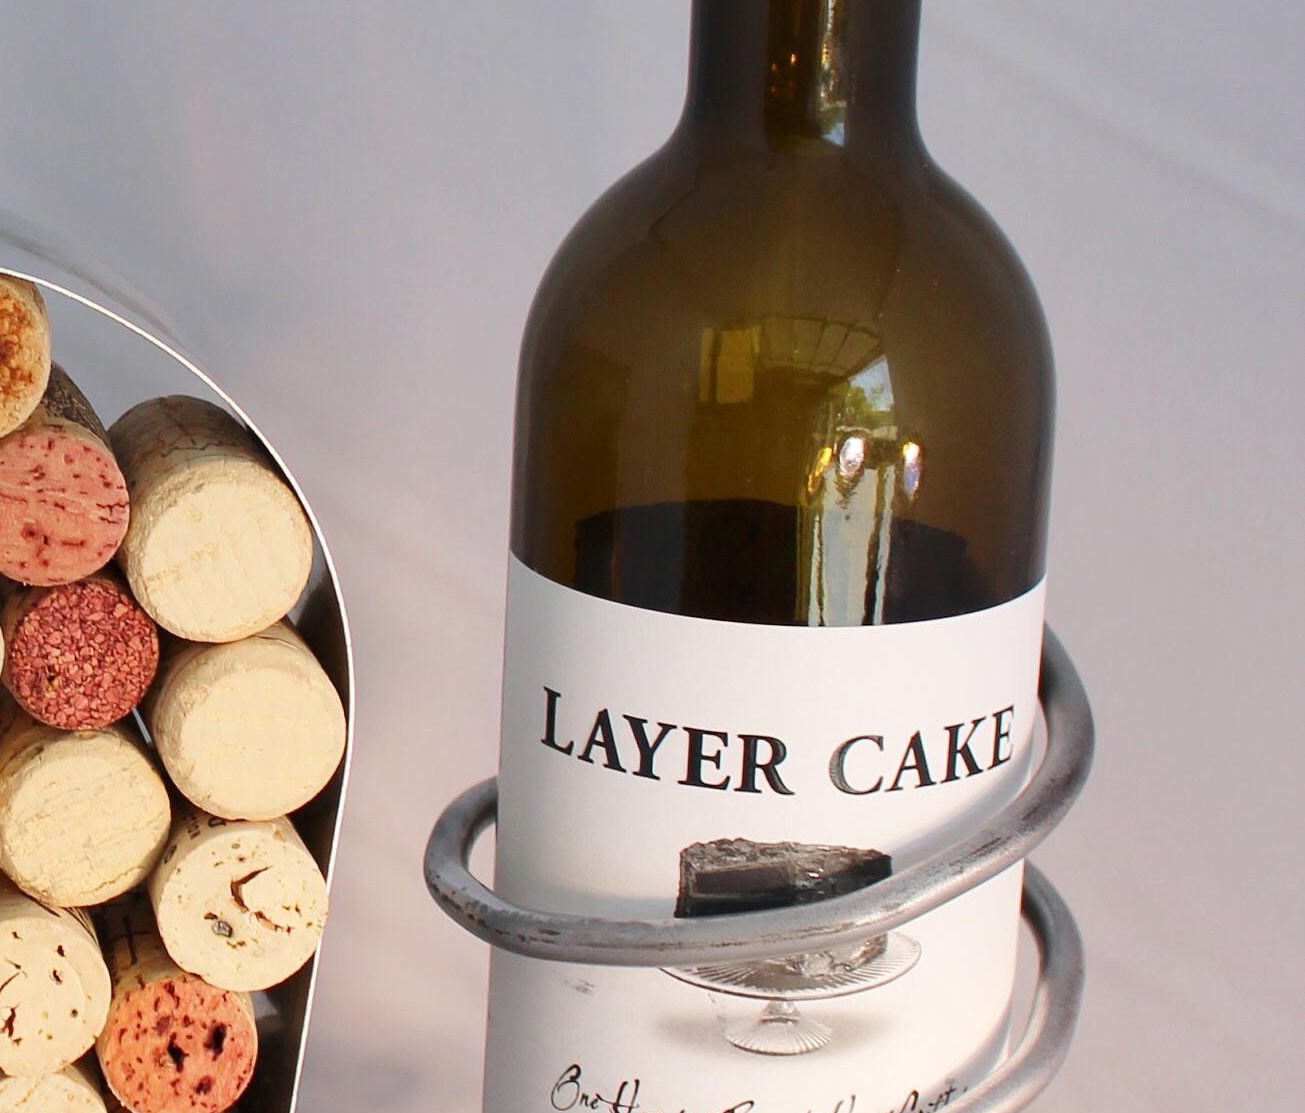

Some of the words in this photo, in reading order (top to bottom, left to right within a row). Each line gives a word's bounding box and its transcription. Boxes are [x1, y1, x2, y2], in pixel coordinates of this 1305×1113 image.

[540, 686, 795, 796] LAYER
[828, 705, 1014, 796] CAKE
[551, 1064, 601, 1111] One
